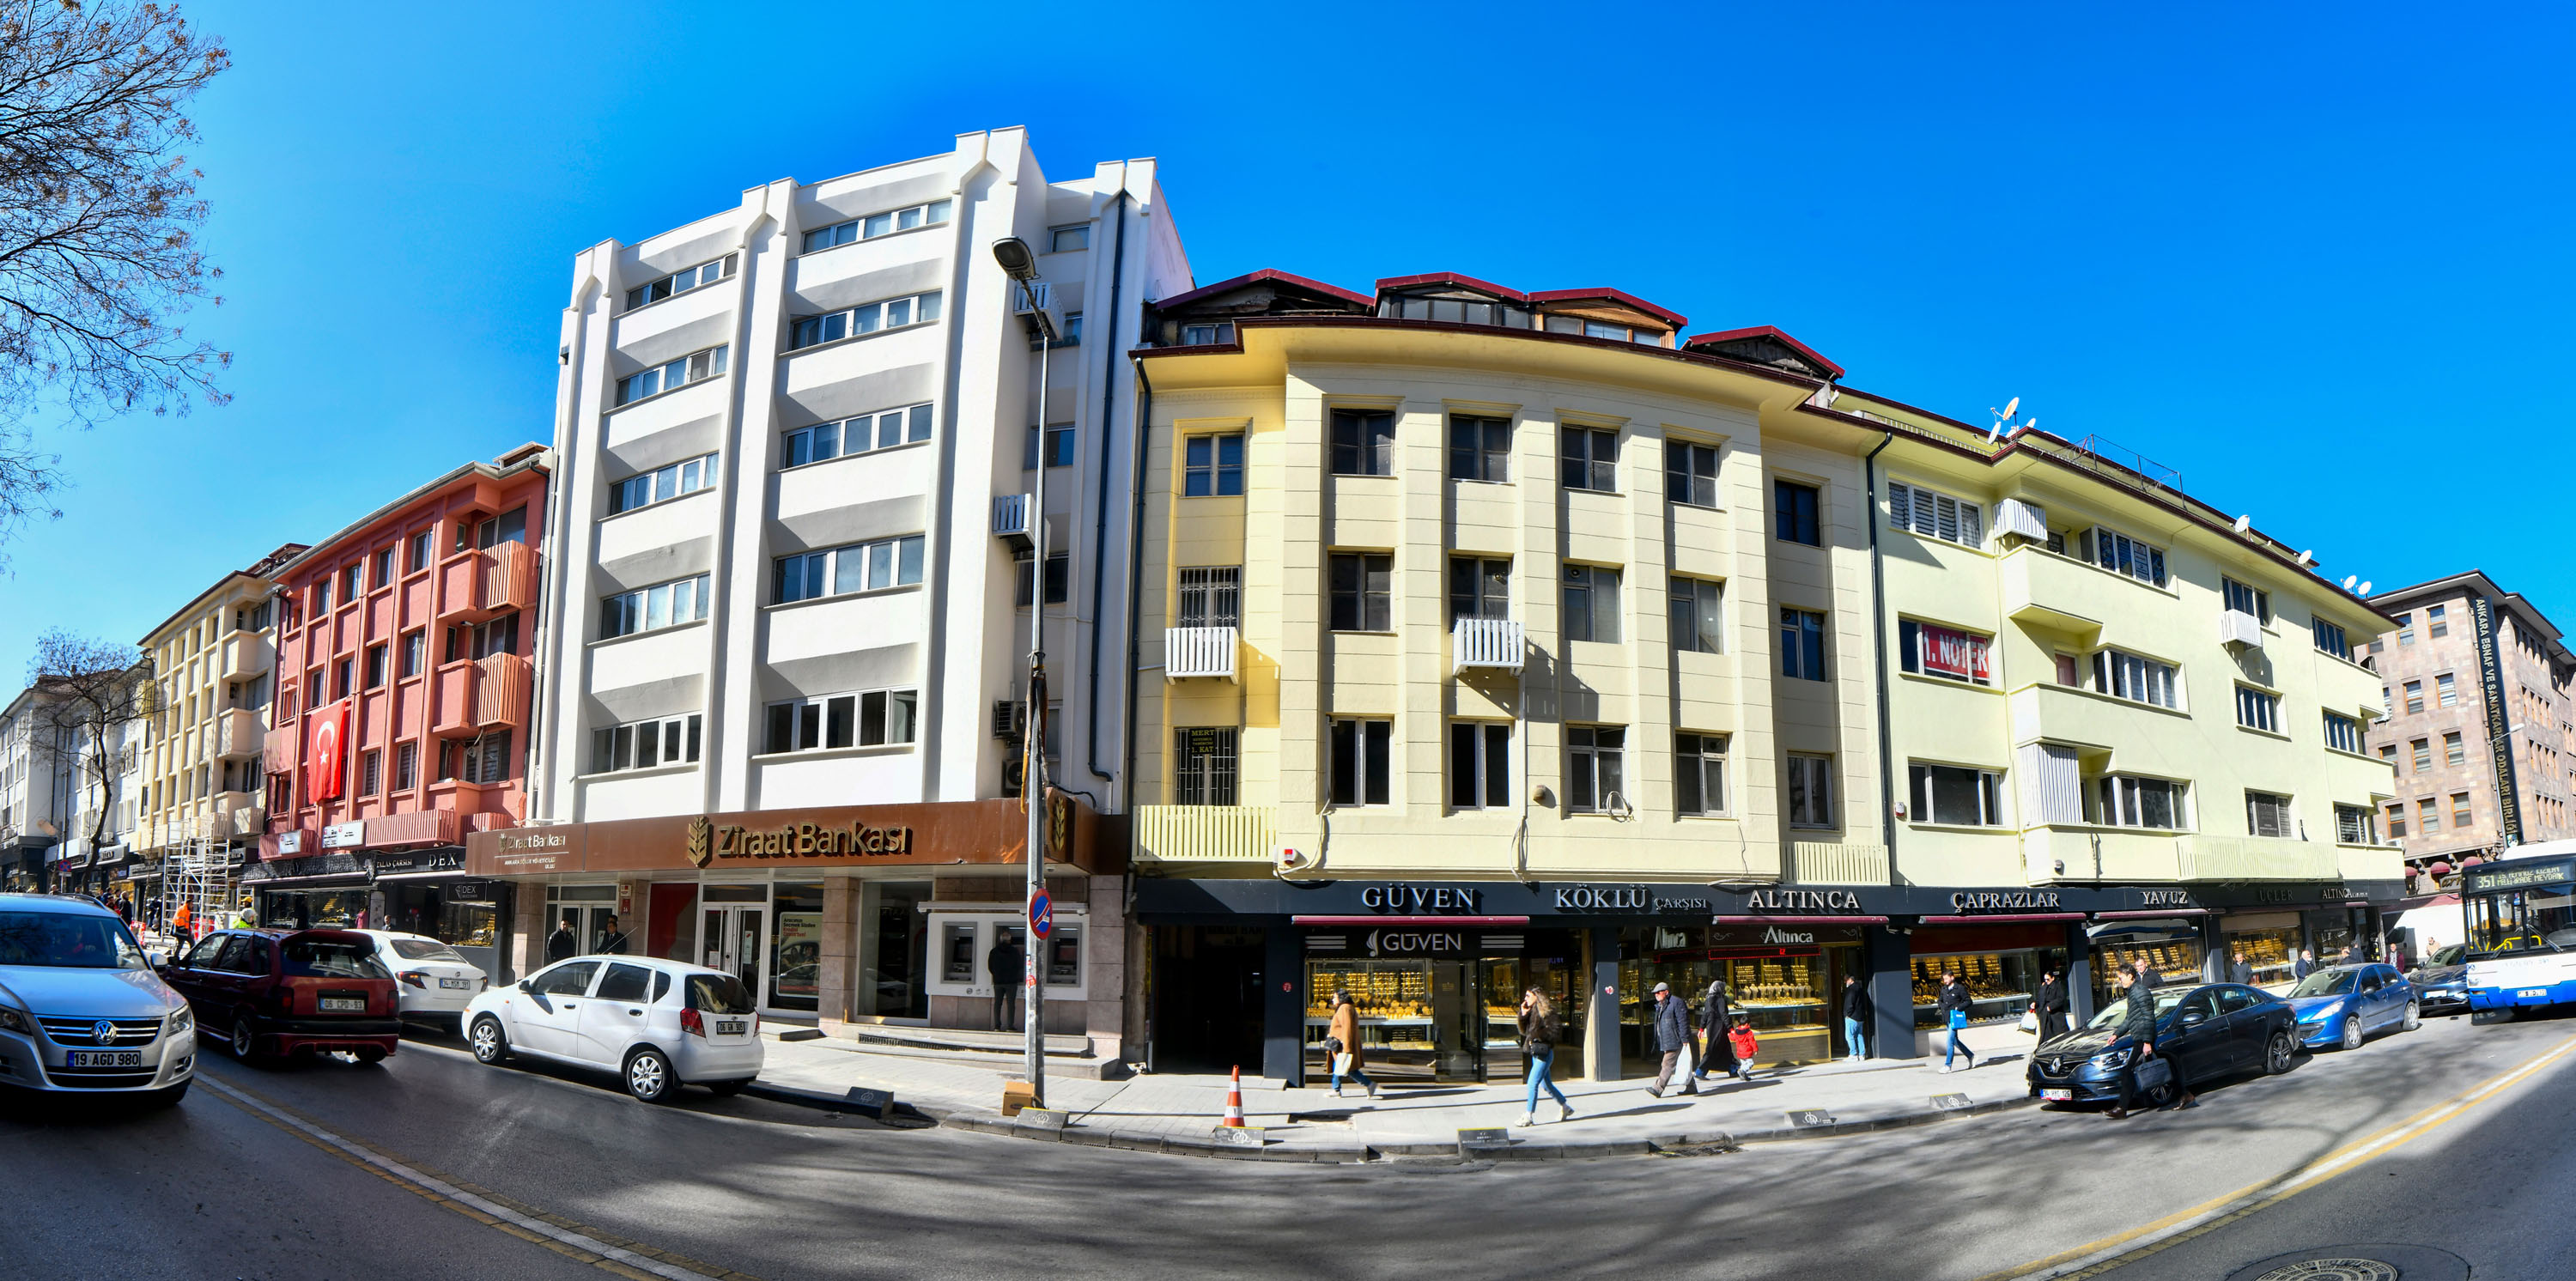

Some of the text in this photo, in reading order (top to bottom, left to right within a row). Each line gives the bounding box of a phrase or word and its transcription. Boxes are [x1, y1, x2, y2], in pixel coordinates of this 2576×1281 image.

[2476, 599, 2489, 636] ANKARA
[1923, 630, 1988, 672] 1. NOTER
[2481, 637, 2494, 667] ESNAF
[2485, 669, 2496, 683] VE
[2496, 755, 2511, 796] ODALARI
[2501, 798, 2518, 835] BİRLİĞİ
[507, 834, 566, 849] Ziraat Bankası
[718, 820, 907, 855] Ziraat Bankası
[429, 853, 457, 867] DEX
[2478, 875, 2495, 889] 351
[1362, 883, 1474, 908] GÜVEN
[1554, 883, 1707, 911] KÖKLÜ ÇARŞISI
[1747, 889, 1860, 908] ALTINCA
[1951, 892, 2059, 913] ÇAPRAZLAR
[2142, 891, 2188, 904] YAVUZ
[2322, 888, 2353, 899] ALTINCA
[1764, 926, 1814, 944] Altınca
[75, 1053, 139, 1066] 19 AGD 980
